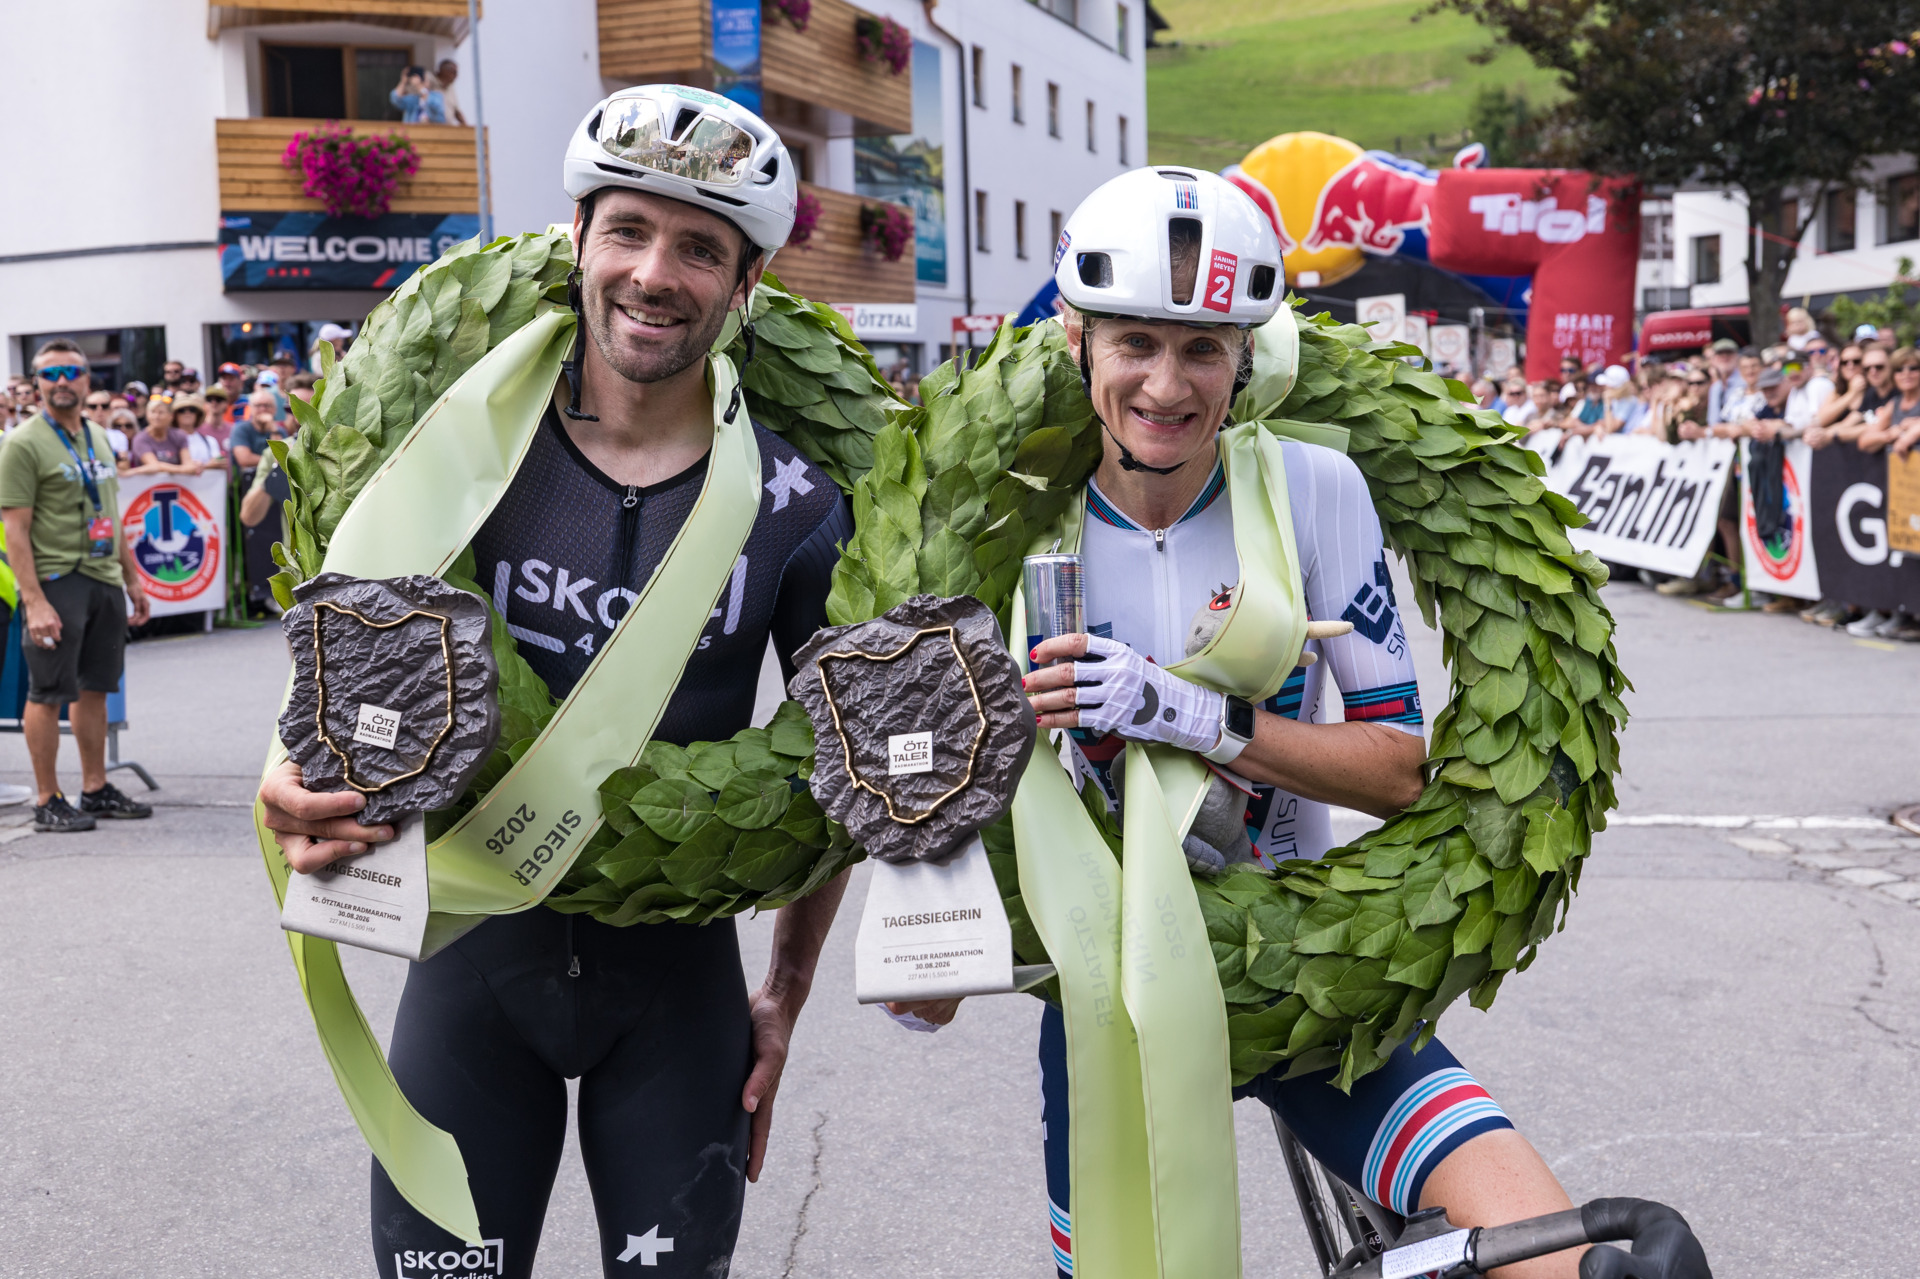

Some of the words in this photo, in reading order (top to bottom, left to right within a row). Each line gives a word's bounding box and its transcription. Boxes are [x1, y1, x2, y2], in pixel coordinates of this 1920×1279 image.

[1468, 192, 1607, 244] Tirol
[238, 235, 433, 262] WELCOME
[1213, 255, 1236, 266] JANINE
[1213, 262, 1235, 273] MEYER
[1211, 275, 1230, 305] 2
[856, 308, 912, 328] ÖTZTAL
[1554, 313, 1614, 331] HEART
[1553, 331, 1576, 349] OF
[1581, 331, 1612, 350] THE
[1568, 456, 1721, 548] Santini
[360, 722, 392, 737] TALER
[372, 714, 395, 728] ÖTZ
[360, 732, 391, 743] RADMARATHON
[904, 740, 928, 751] ÖTZ
[893, 752, 928, 762] TALER
[486, 803, 536, 855] 2026
[510, 809, 582, 887] SIEGER
[324, 863, 402, 888] TAGESSIEGER
[311, 895, 321, 904] 45.
[321, 897, 352, 911] ÖTZTALER
[352, 905, 401, 922] RADMARATHON
[338, 910, 370, 923] 30.08.2026
[882, 908, 982, 928] TAGESSIEGERIN
[883, 956, 894, 964] 45.
[895, 954, 928, 963] ÖTZTALER
[929, 949, 983, 960] RADMARATHON
[915, 961, 950, 970] 30.08.2026
[403, 1249, 495, 1270] SKOOL
